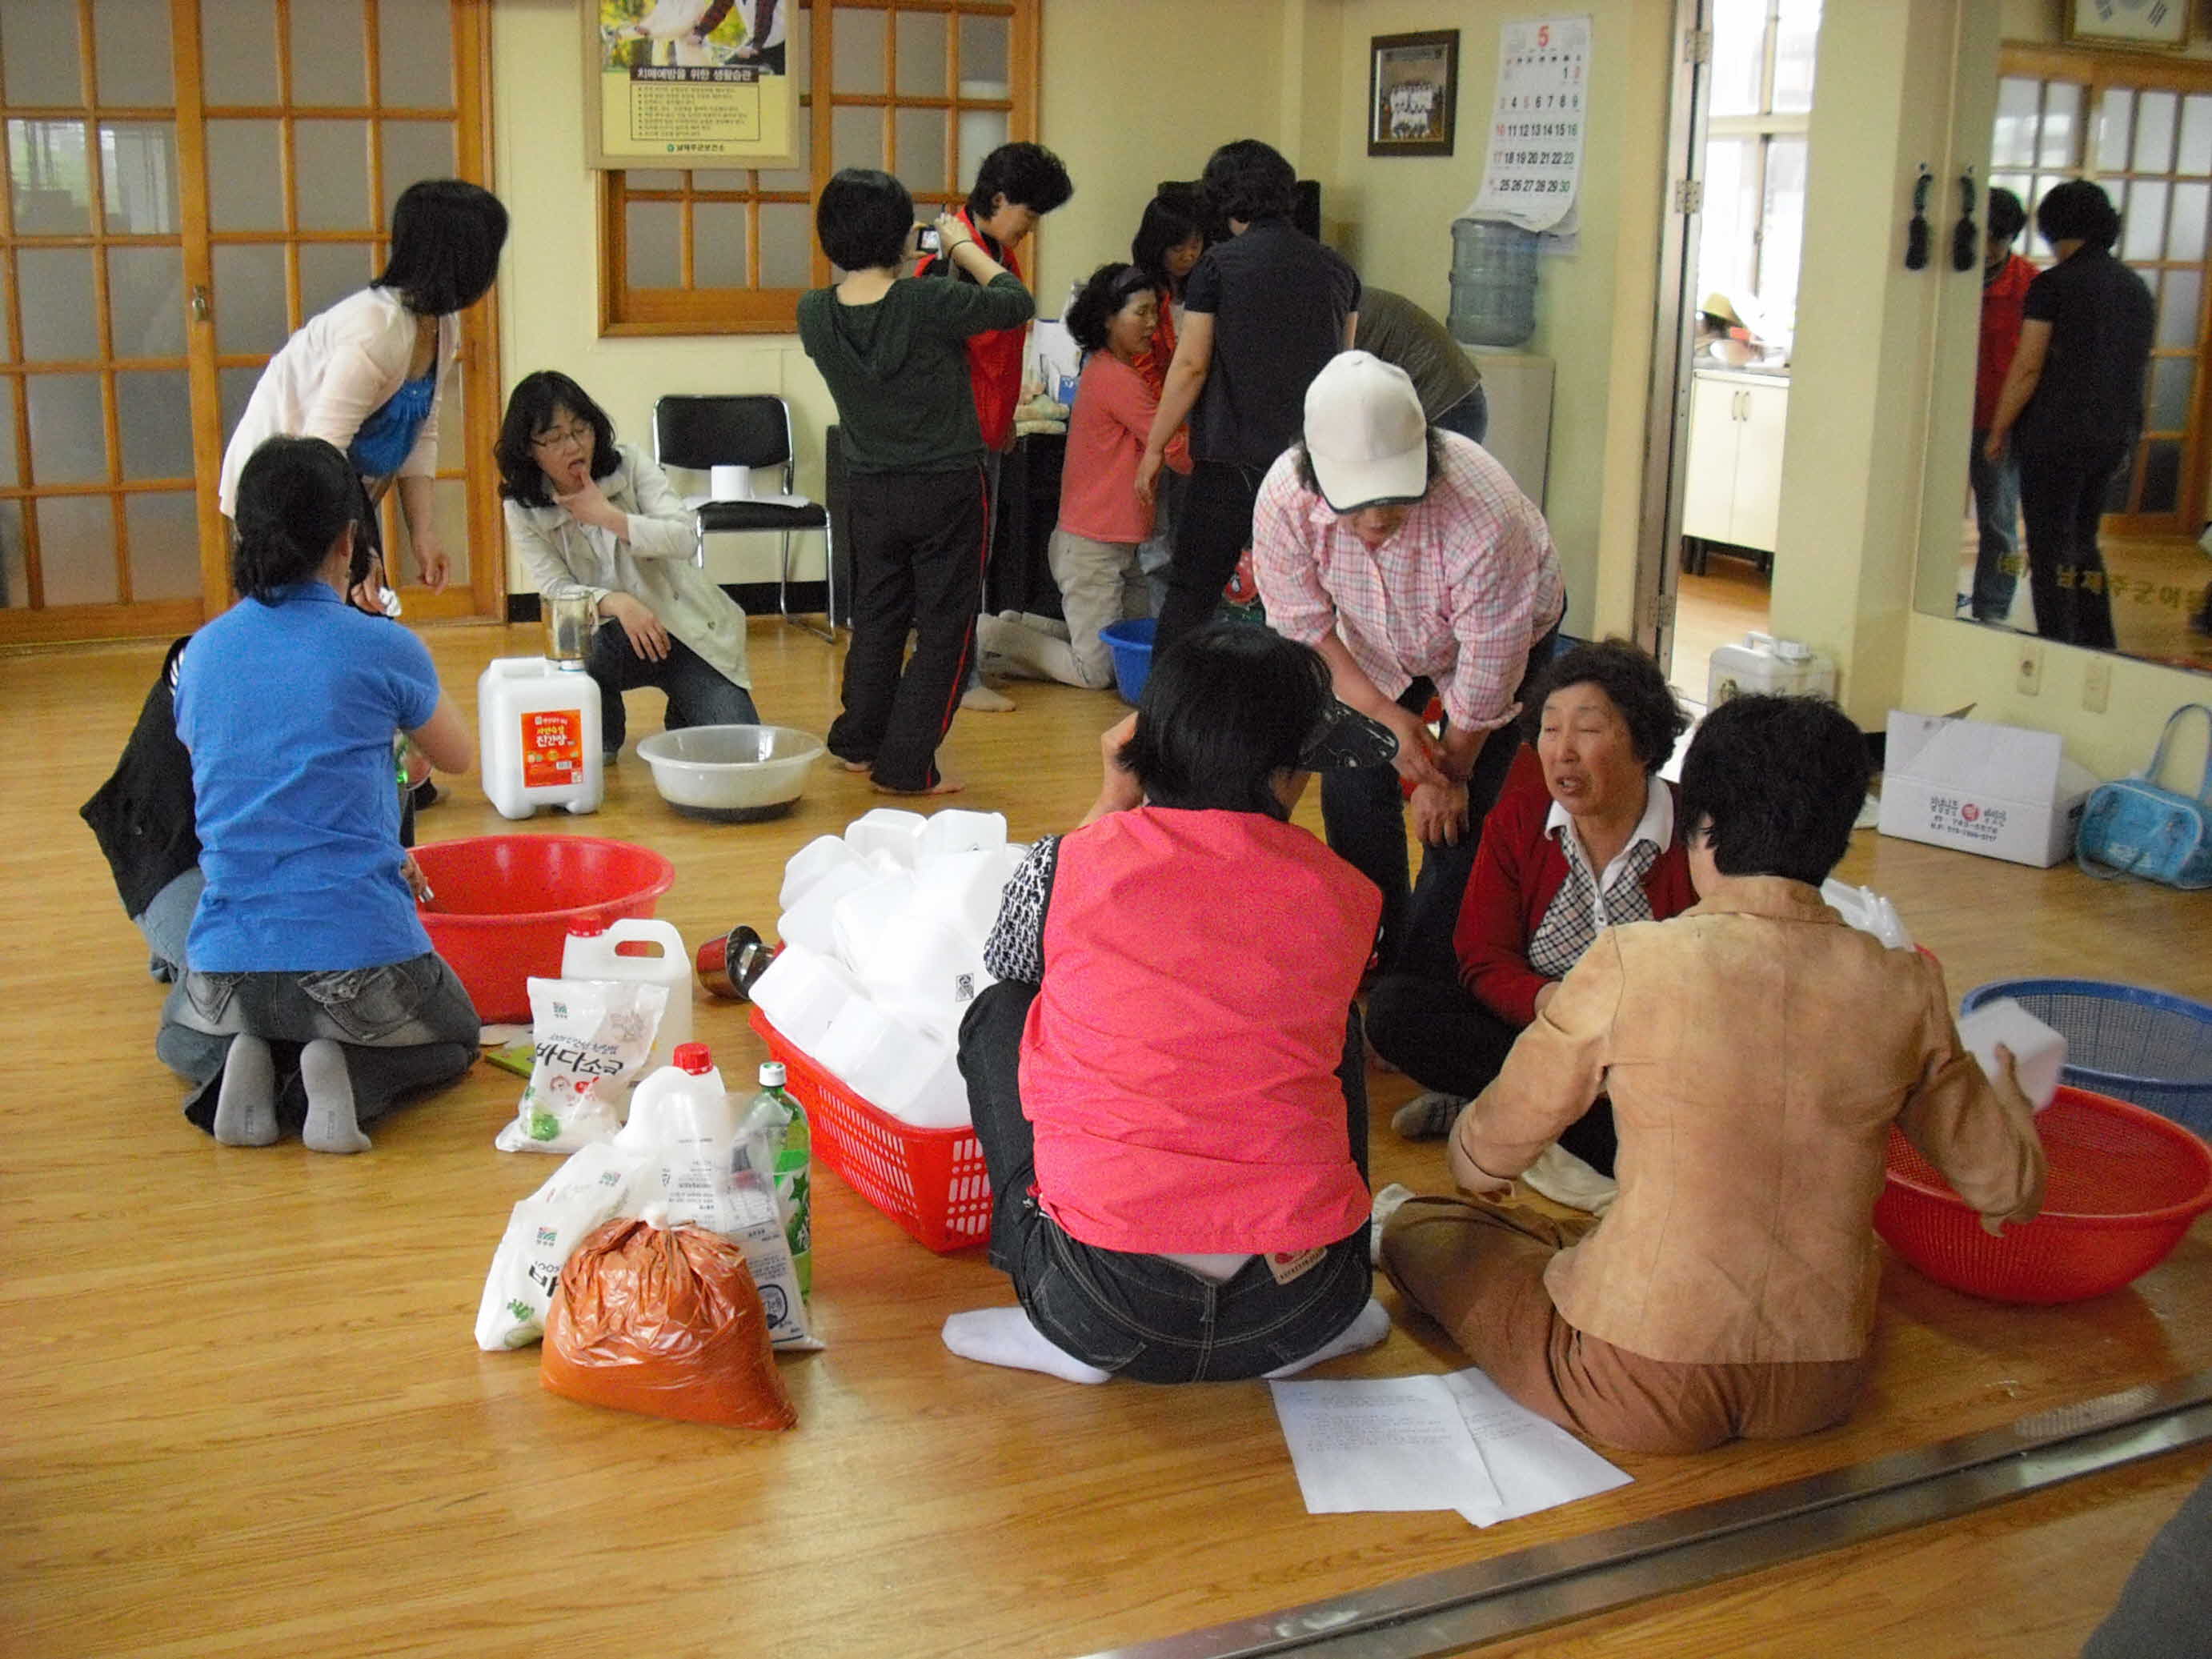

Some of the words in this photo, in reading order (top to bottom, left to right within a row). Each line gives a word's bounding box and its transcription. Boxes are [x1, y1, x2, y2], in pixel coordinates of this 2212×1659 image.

[1537, 26, 1549, 47] 5
[1548, 95, 1554, 108] 7
[1508, 124, 1517, 137] 11
[1519, 124, 1529, 137] 12
[1532, 124, 1541, 137] 13
[1543, 124, 1553, 136] 14
[1555, 123, 1565, 136] 15
[1505, 151, 1514, 164] 18
[1517, 151, 1526, 164] 19
[1528, 151, 1538, 164] 20
[1540, 152, 1550, 164] 21
[1552, 152, 1563, 165] 22
[1564, 152, 1575, 165] 23
[1500, 179, 1510, 192] 25
[1511, 179, 1522, 192] 26
[1523, 179, 1534, 192] 27
[1535, 179, 1546, 192] 28
[1547, 180, 1558, 193] 29
[536, 1043, 623, 1076] 바다소금
